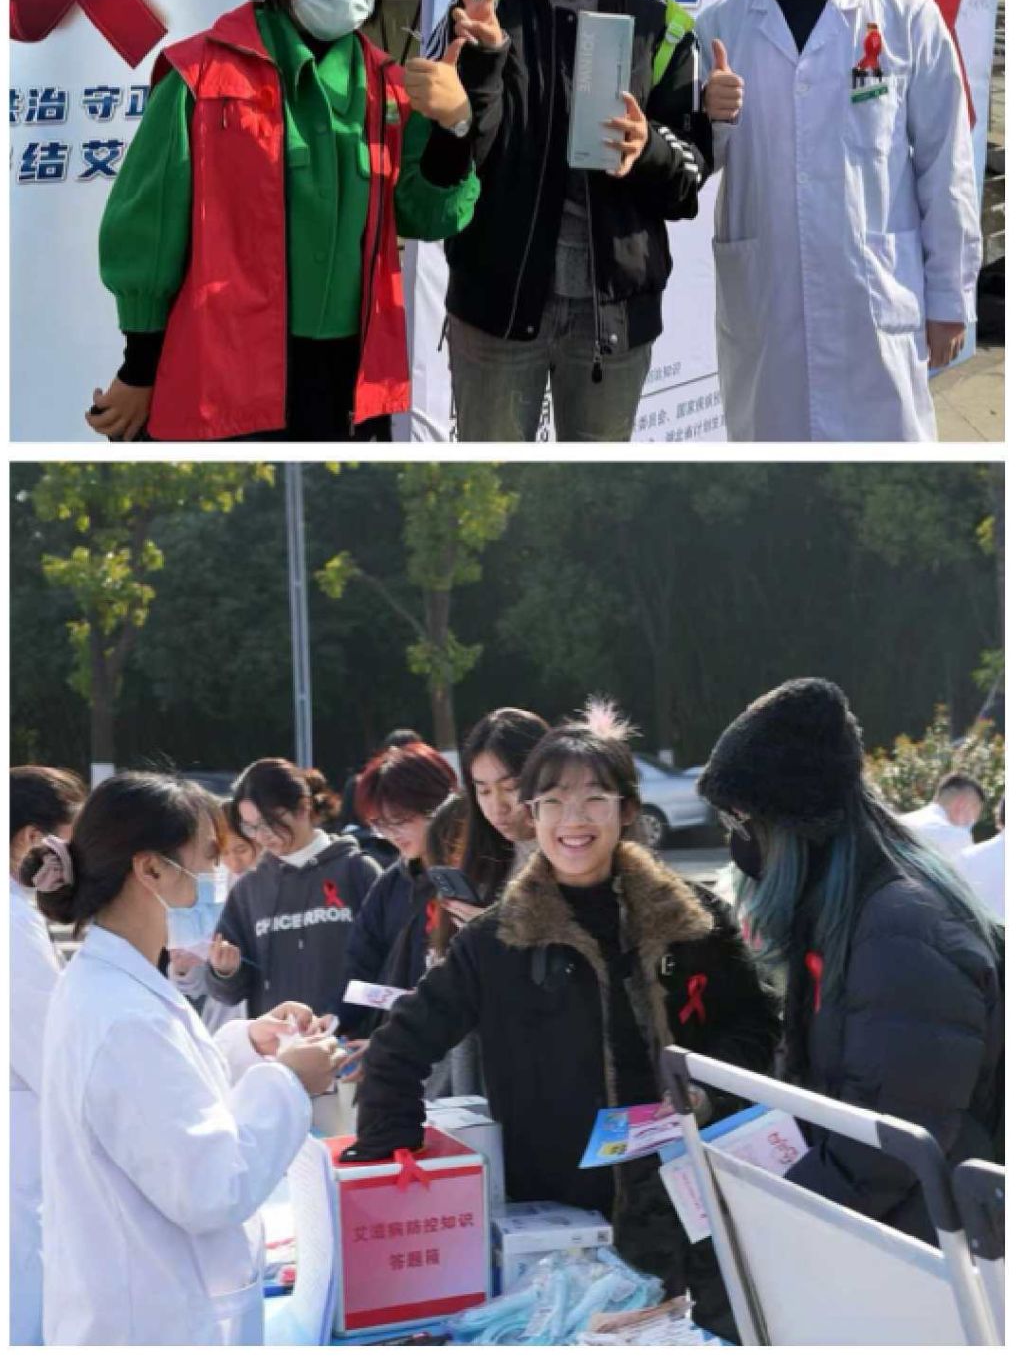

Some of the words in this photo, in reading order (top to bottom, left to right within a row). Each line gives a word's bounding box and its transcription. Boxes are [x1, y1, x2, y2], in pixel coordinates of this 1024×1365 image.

[352, 1212, 475, 1243] 艾滋病防控知识
[389, 1248, 440, 1271] 答题箱
